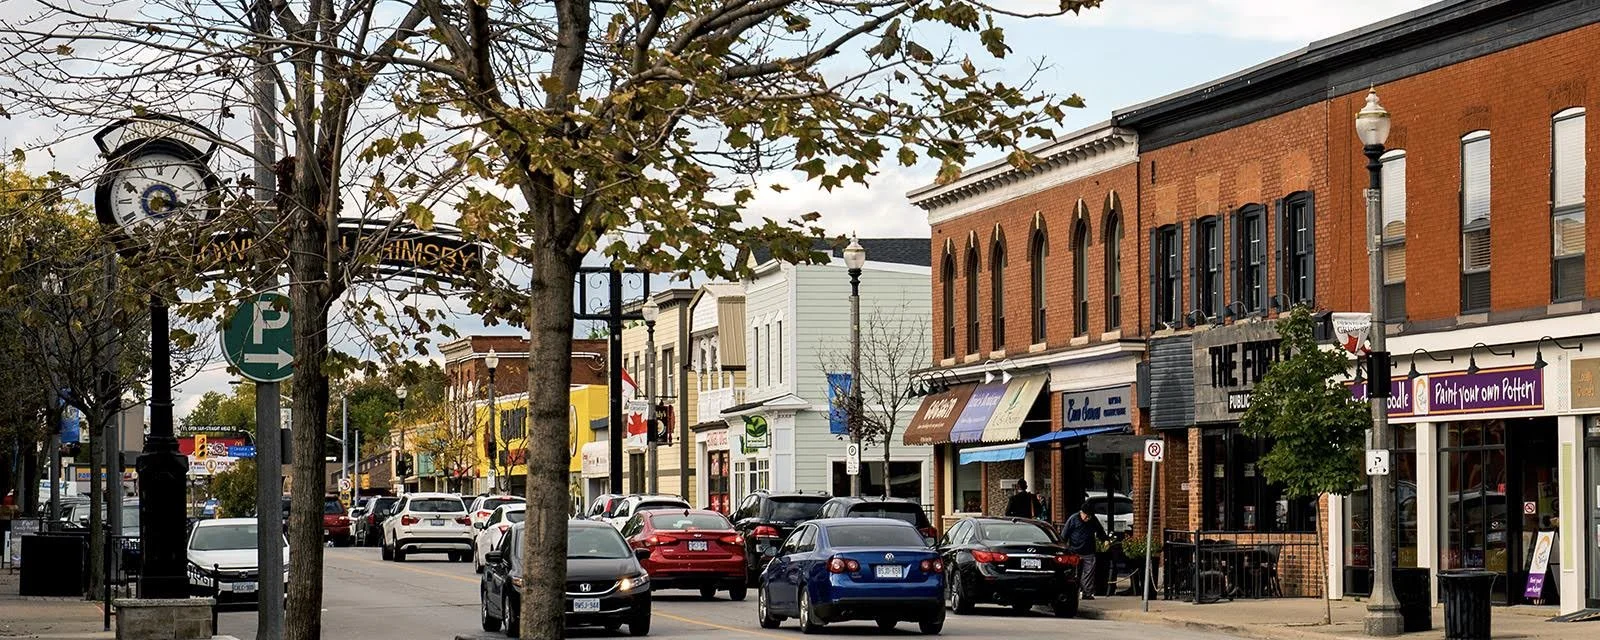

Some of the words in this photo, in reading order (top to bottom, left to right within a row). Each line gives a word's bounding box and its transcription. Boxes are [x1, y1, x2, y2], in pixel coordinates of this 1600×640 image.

[360, 236, 476, 270] RIMSBY
[253, 300, 290, 344] P
[1209, 344, 1238, 389] THE
[1242, 339, 1292, 386] FORT
[1387, 381, 1409, 409] oodle
[1435, 380, 1457, 405] Paint
[1459, 385, 1480, 410] your
[1481, 384, 1500, 402] own
[1502, 377, 1536, 406] Pottery
